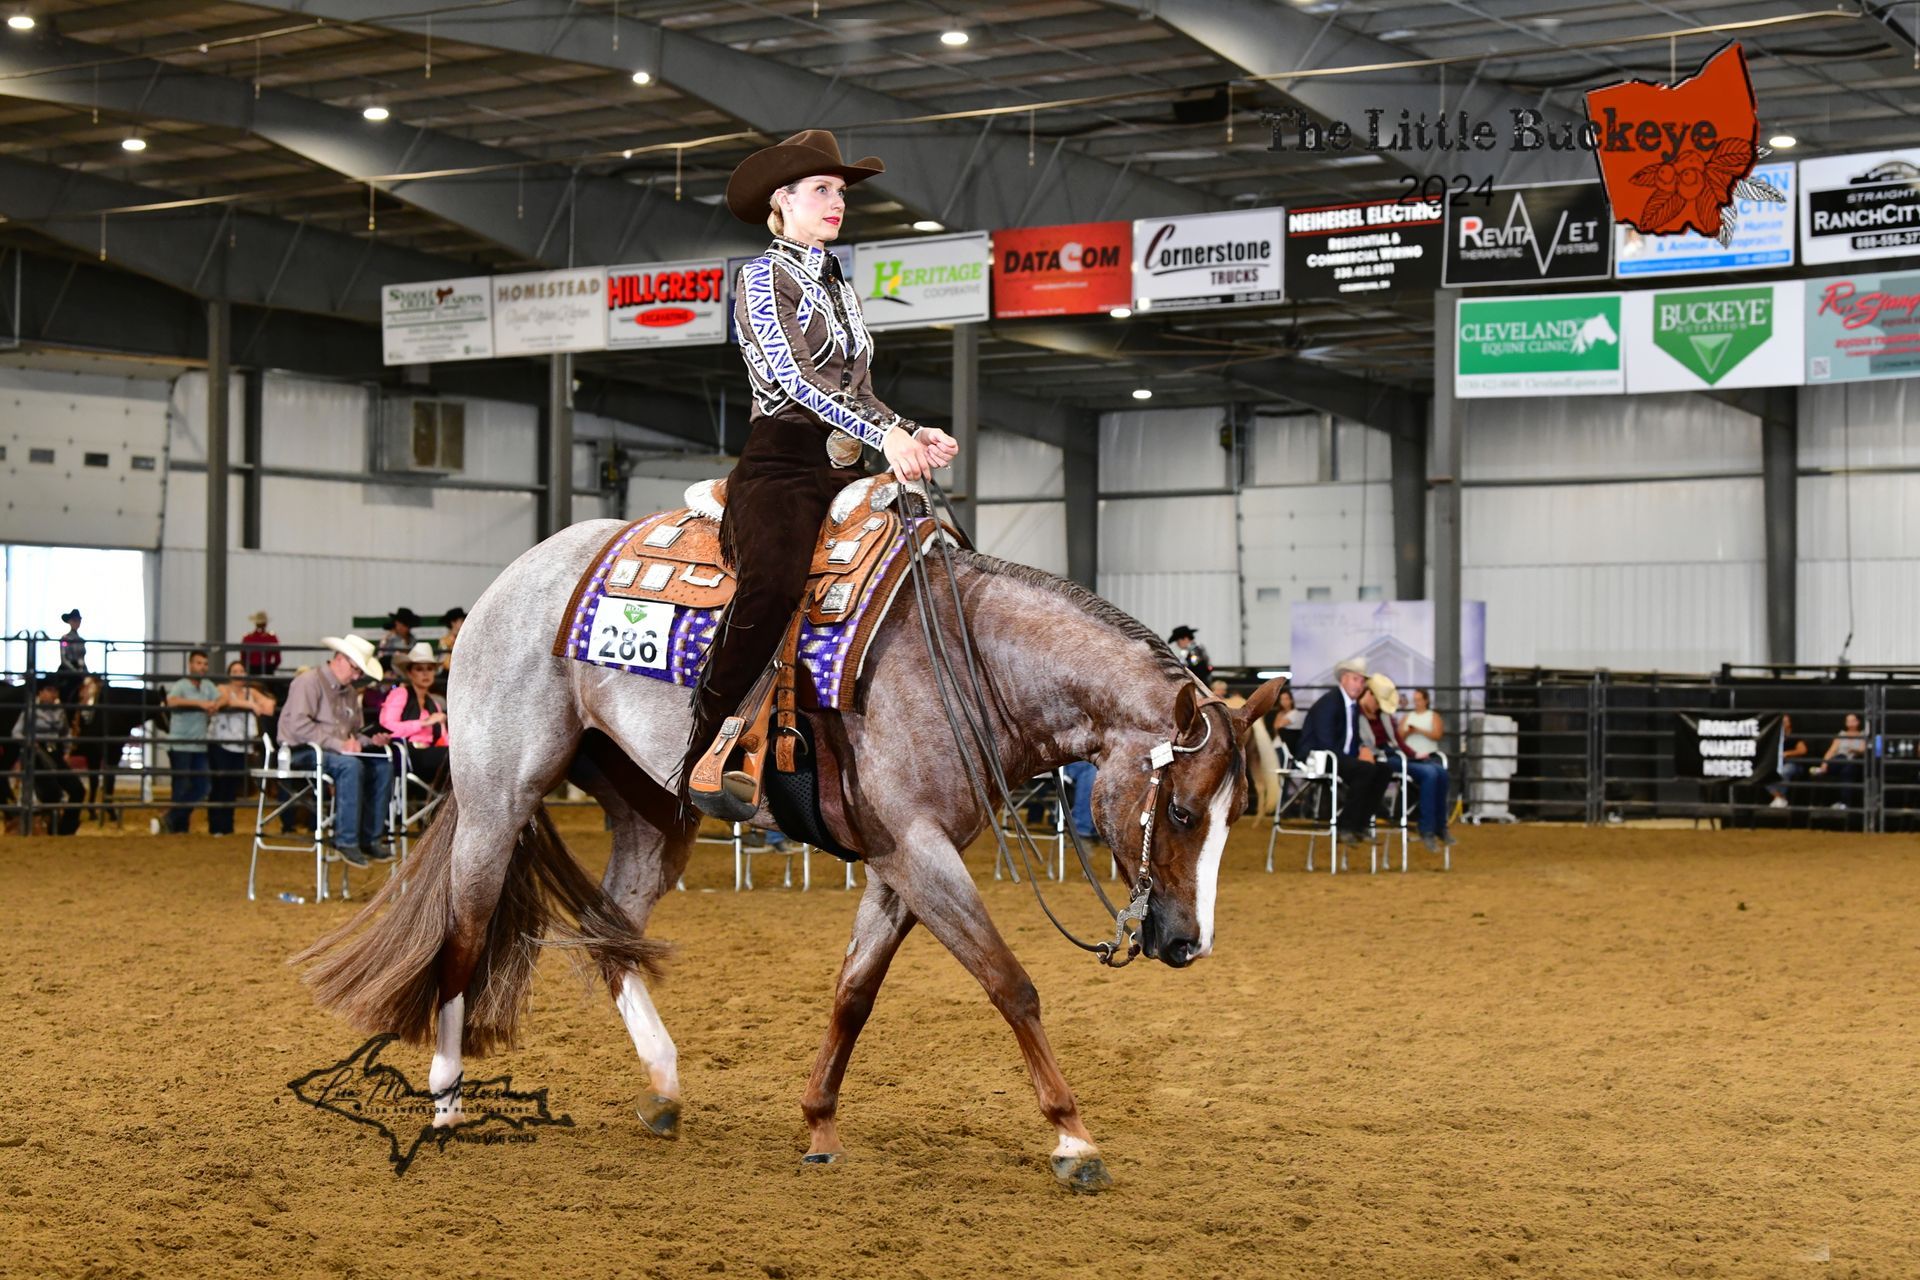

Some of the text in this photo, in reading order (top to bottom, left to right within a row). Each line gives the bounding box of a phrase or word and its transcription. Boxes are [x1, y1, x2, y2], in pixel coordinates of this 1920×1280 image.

[1846, 188, 1916, 204] STRAIGHT
[1366, 200, 1442, 225] ELECTRIC
[1003, 242, 1121, 273] DATACOM
[1144, 224, 1270, 268] Cornerstone
[1460, 242, 1599, 260] THERAPEUTIC SYSTEMS
[871, 260, 983, 297] HERITAGE
[1210, 267, 1259, 285] TRUCKS
[498, 278, 601, 302] HOMESTEAD
[608, 268, 724, 309] HILLCREST
[923, 285, 981, 299] COOPERATIVE
[1660, 298, 1767, 331] BUCKEYE
[1461, 320, 1577, 342] CLEVELAND
[1676, 321, 1748, 334] NUTRITION
[1481, 338, 1570, 356] EQUINE CLINIC
[598, 625, 658, 663] 286
[1699, 739, 1757, 757] QUARTER
